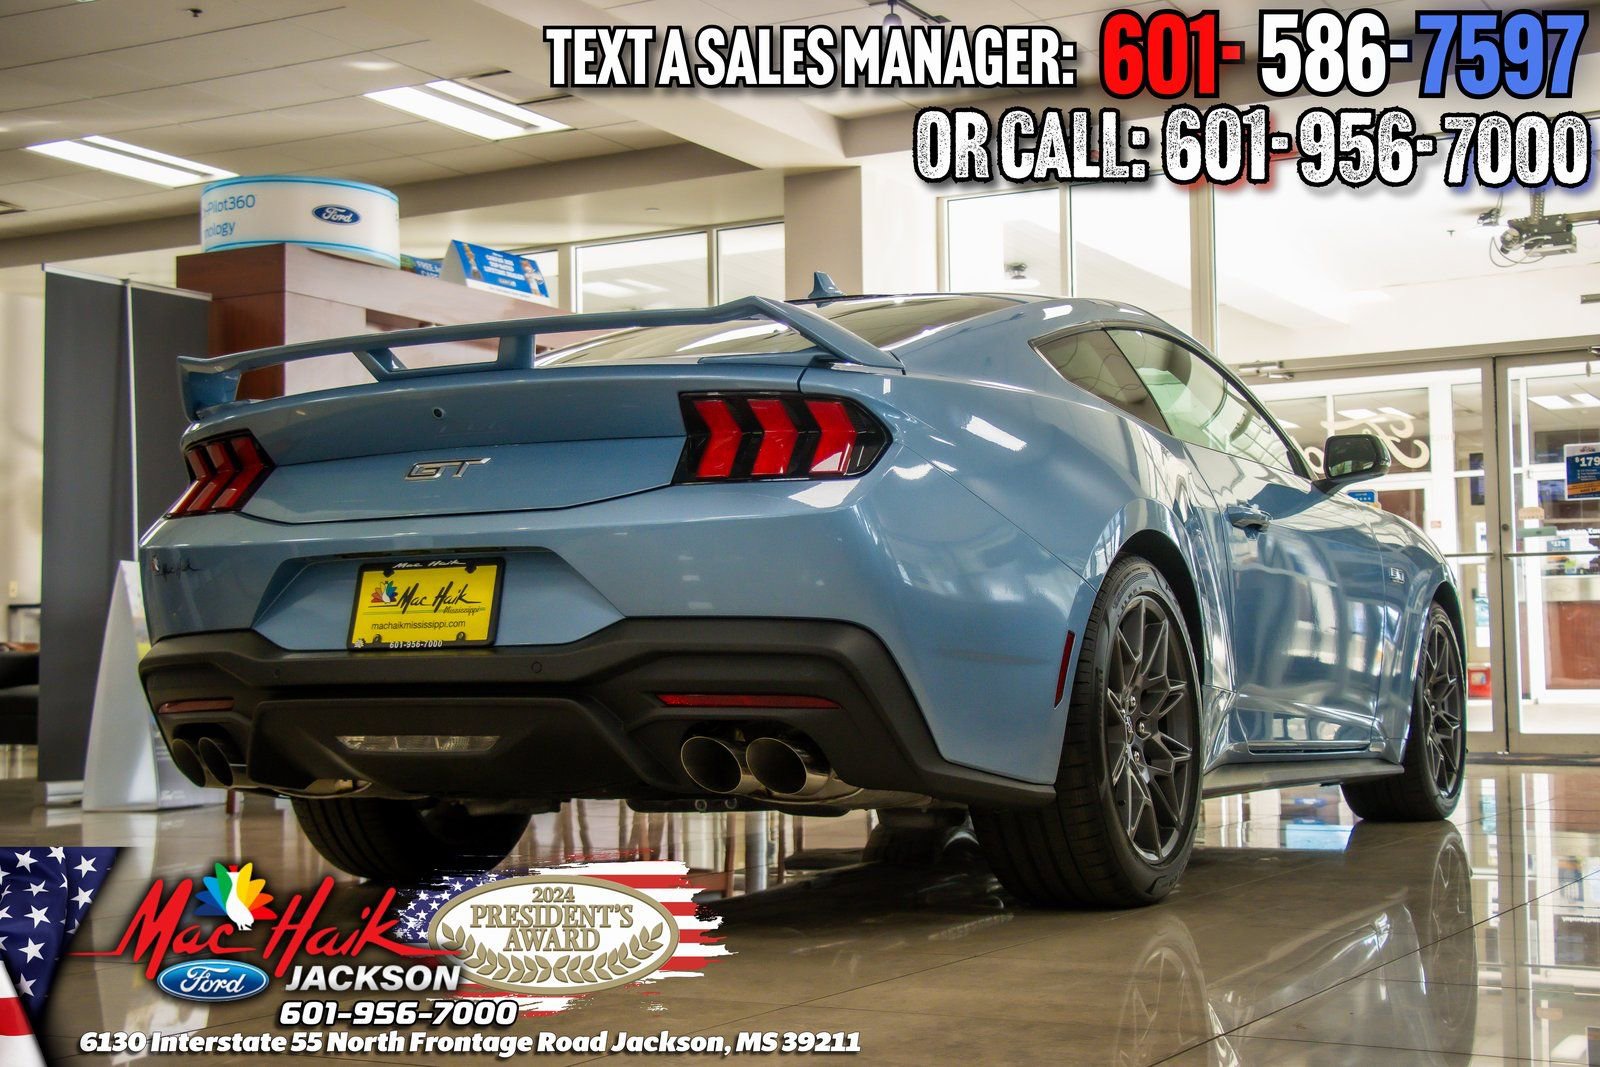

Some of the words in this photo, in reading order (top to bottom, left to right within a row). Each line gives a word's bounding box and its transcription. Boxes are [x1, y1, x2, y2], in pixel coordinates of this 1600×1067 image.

[322, 207, 353, 222] Ford
[404, 458, 491, 481] GT
[428, 559, 466, 567] Haik
[376, 583, 430, 614] Mac
[432, 581, 481, 613] Haik
[443, 606, 481, 616] Mississippi
[371, 620, 465, 630] machaikmississippi.com
[390, 640, 443, 648] 601-956-7000
